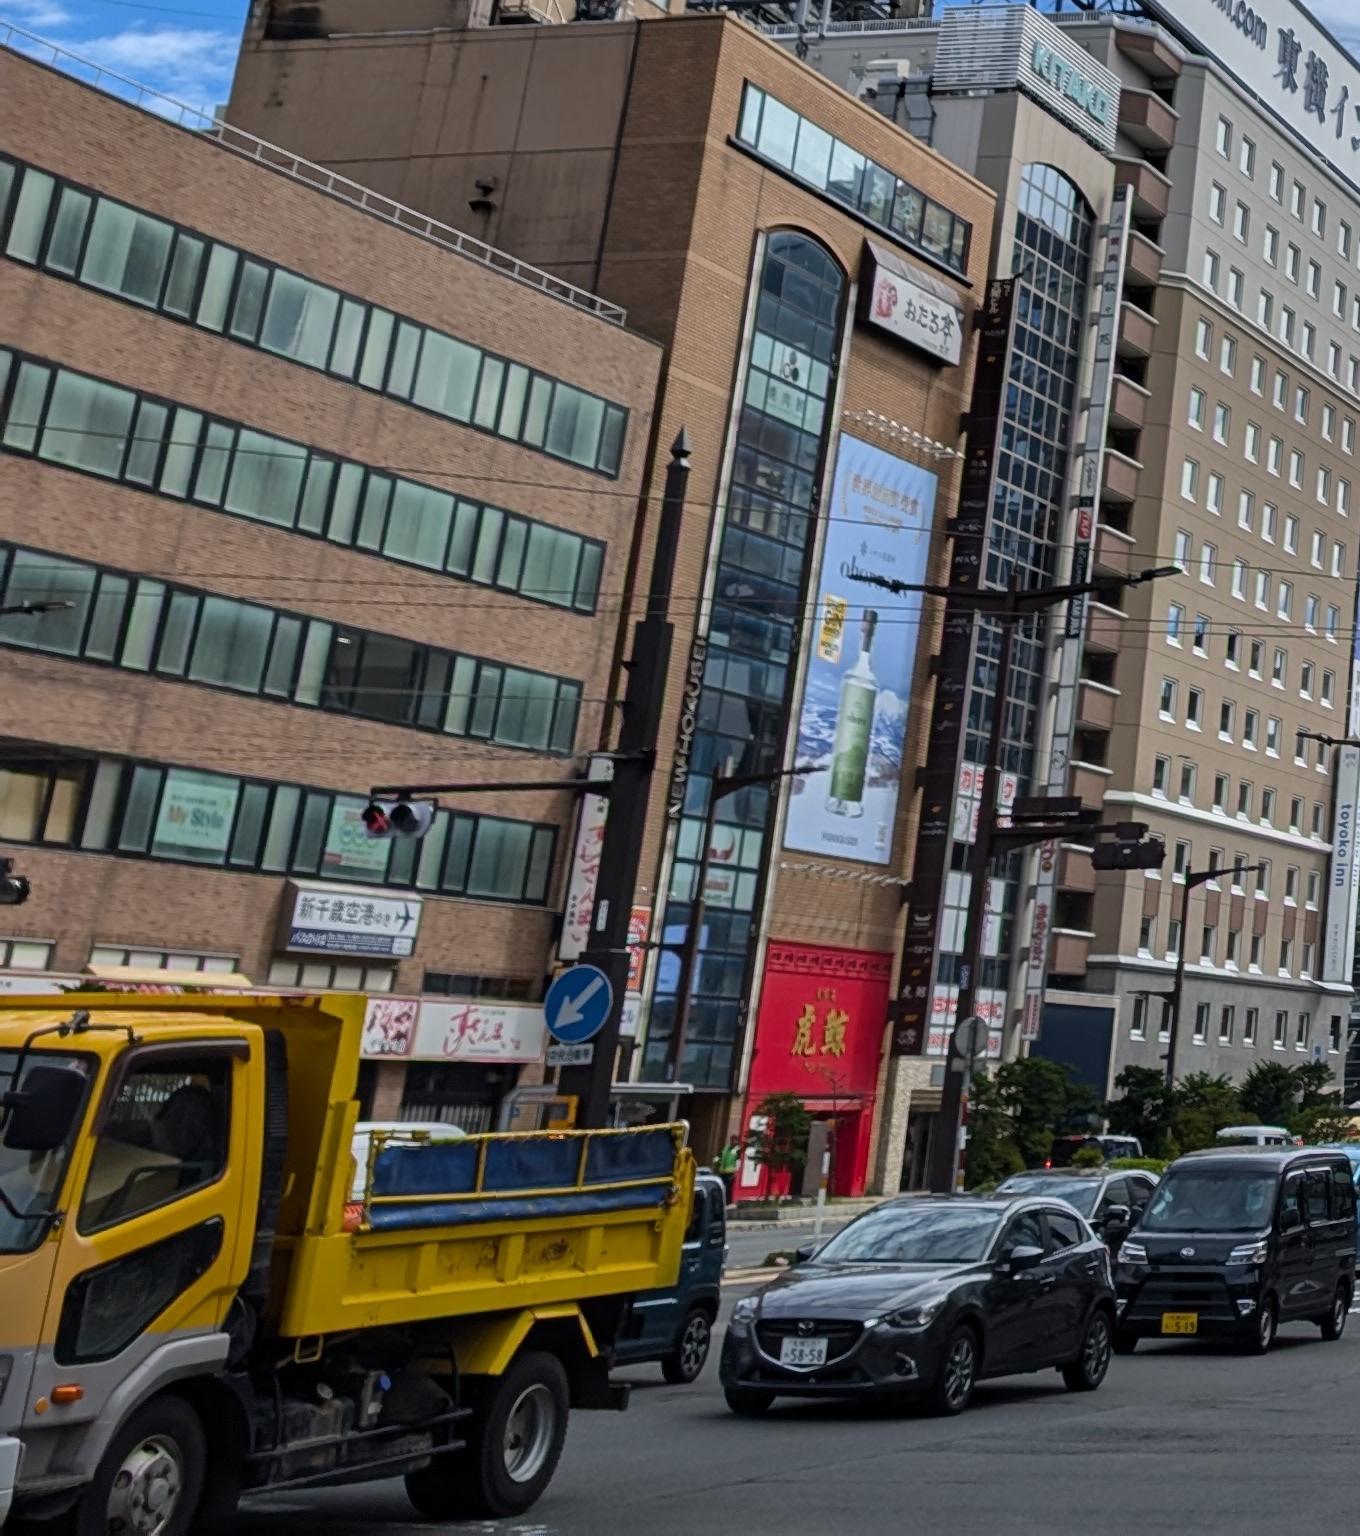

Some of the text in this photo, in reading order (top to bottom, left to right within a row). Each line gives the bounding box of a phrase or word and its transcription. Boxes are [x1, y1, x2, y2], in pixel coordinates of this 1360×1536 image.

[669, 762, 690, 820] NEW
[1334, 803, 1354, 888] toyoko inn
